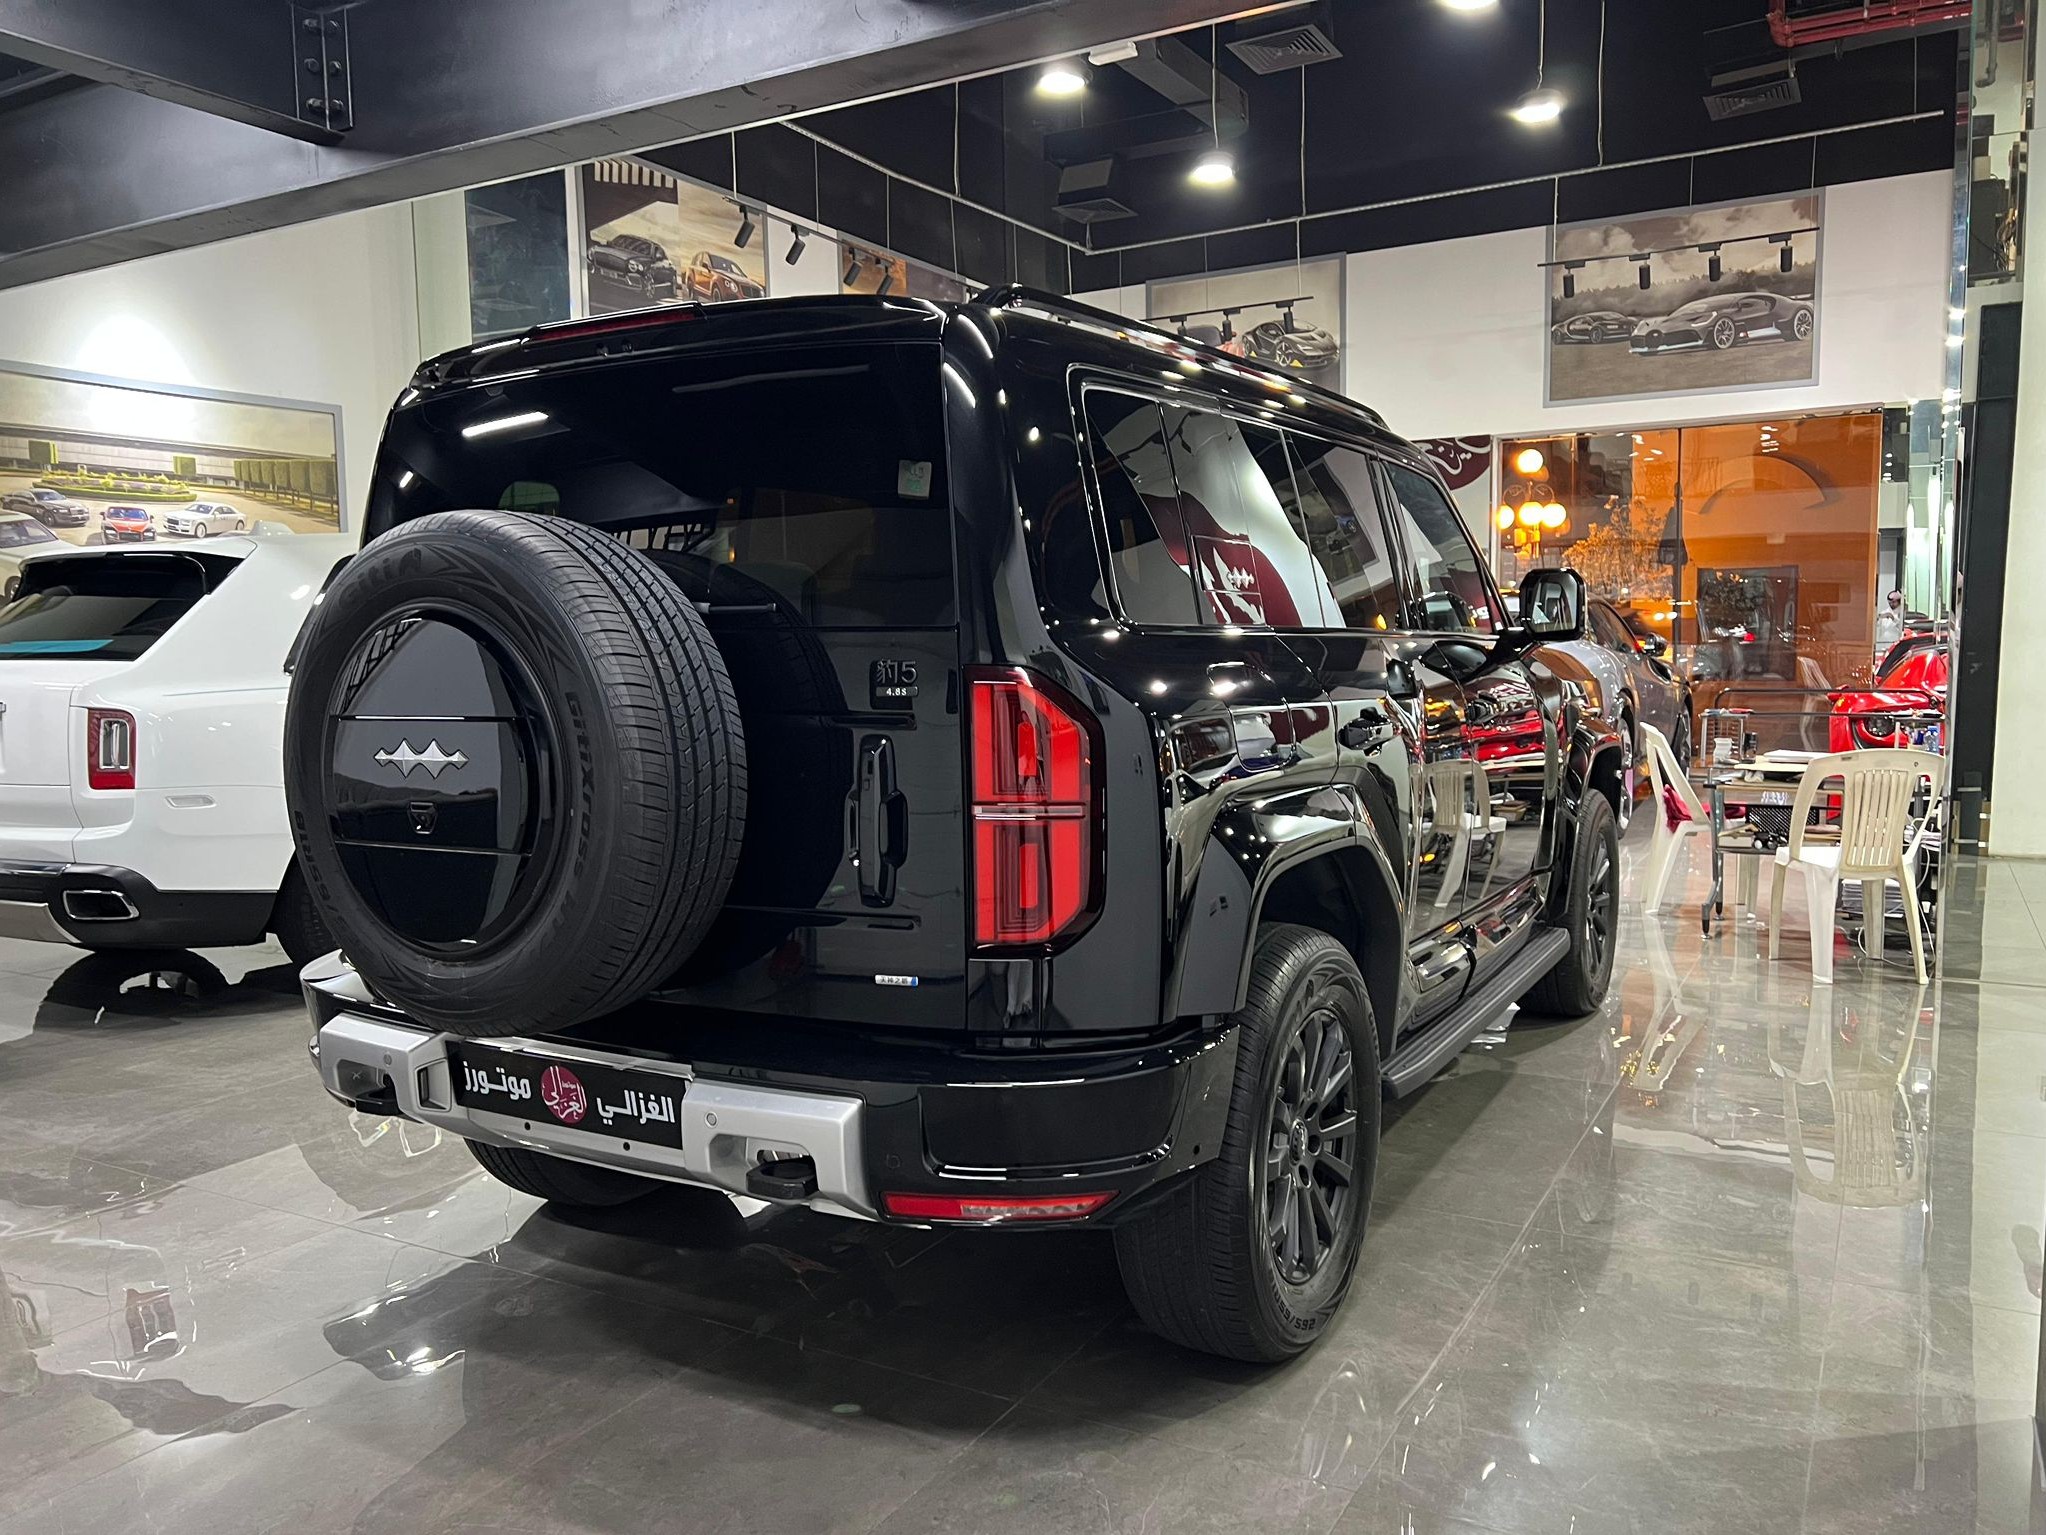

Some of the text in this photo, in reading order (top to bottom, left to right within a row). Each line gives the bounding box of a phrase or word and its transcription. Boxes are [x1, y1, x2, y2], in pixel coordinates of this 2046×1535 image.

[886, 687, 907, 697] 4.8S
[462, 1060, 676, 1126] الغزالي موتورز
